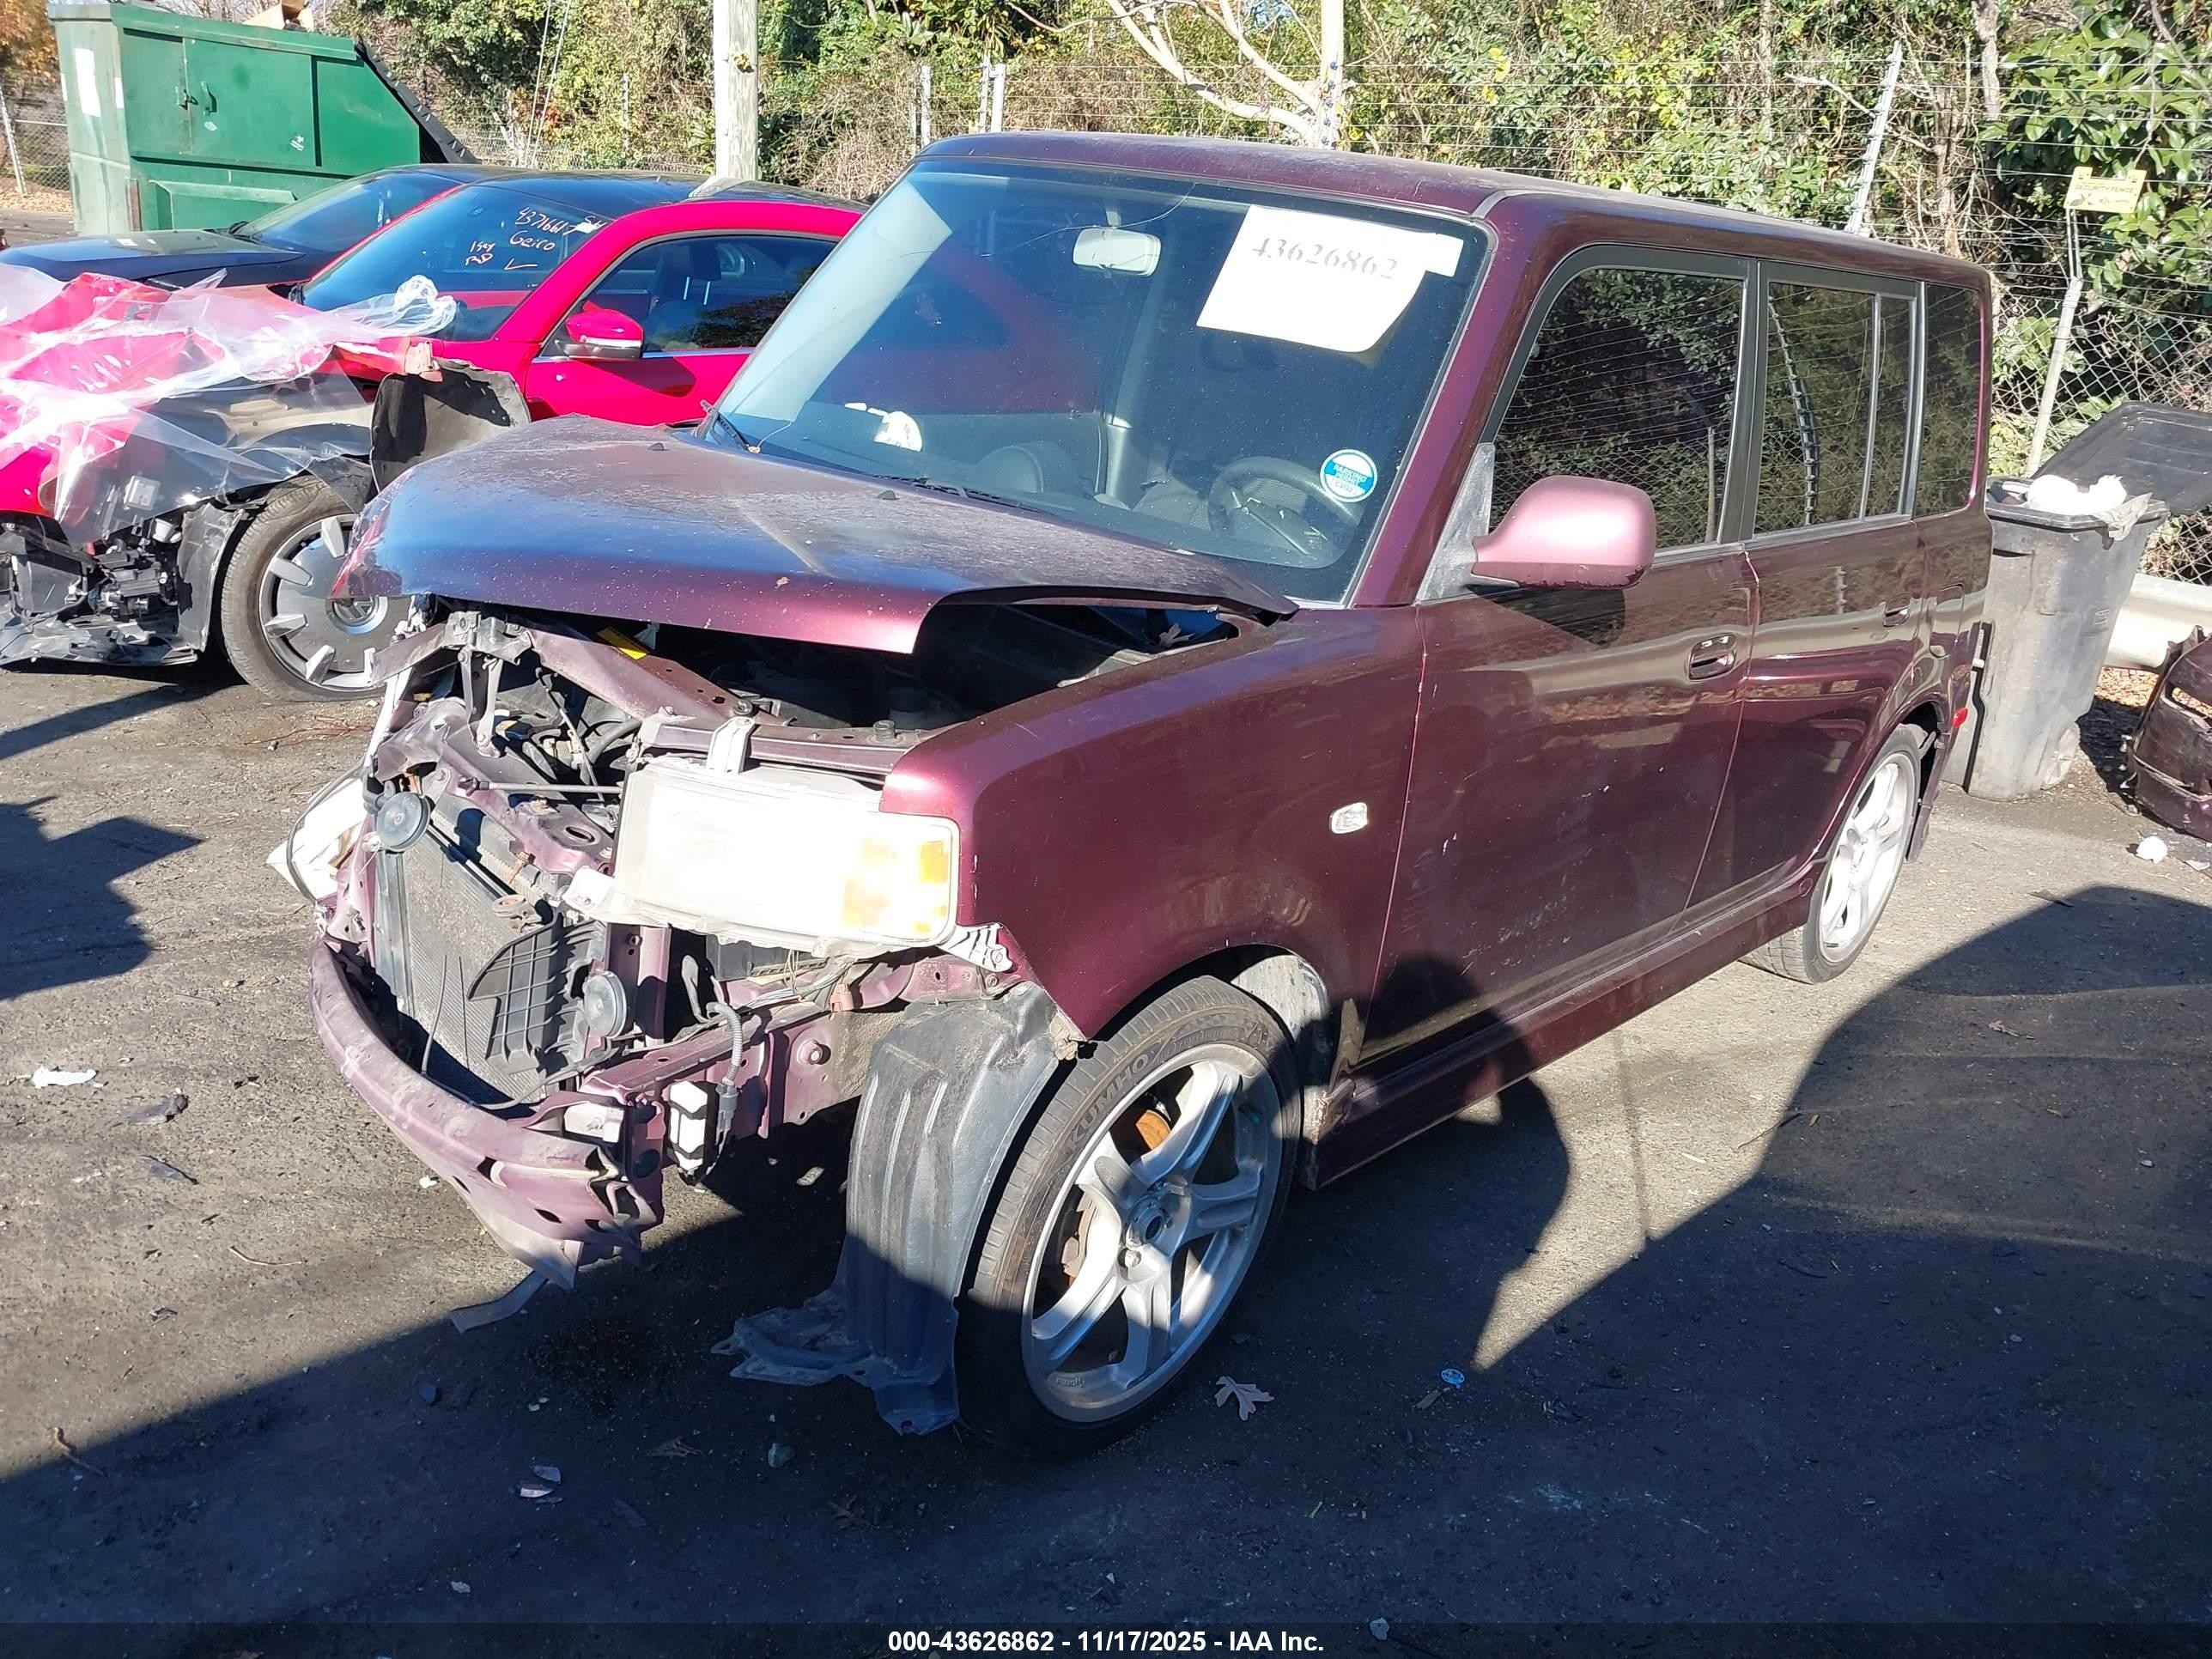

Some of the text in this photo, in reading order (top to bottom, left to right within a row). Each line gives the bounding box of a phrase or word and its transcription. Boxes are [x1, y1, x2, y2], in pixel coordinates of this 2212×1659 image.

[509, 230, 555, 251] Geico
[1251, 237, 1398, 279] 43626862
[1333, 464, 1368, 483] PARKING
[1066, 1053, 1150, 1146] KUMHO
